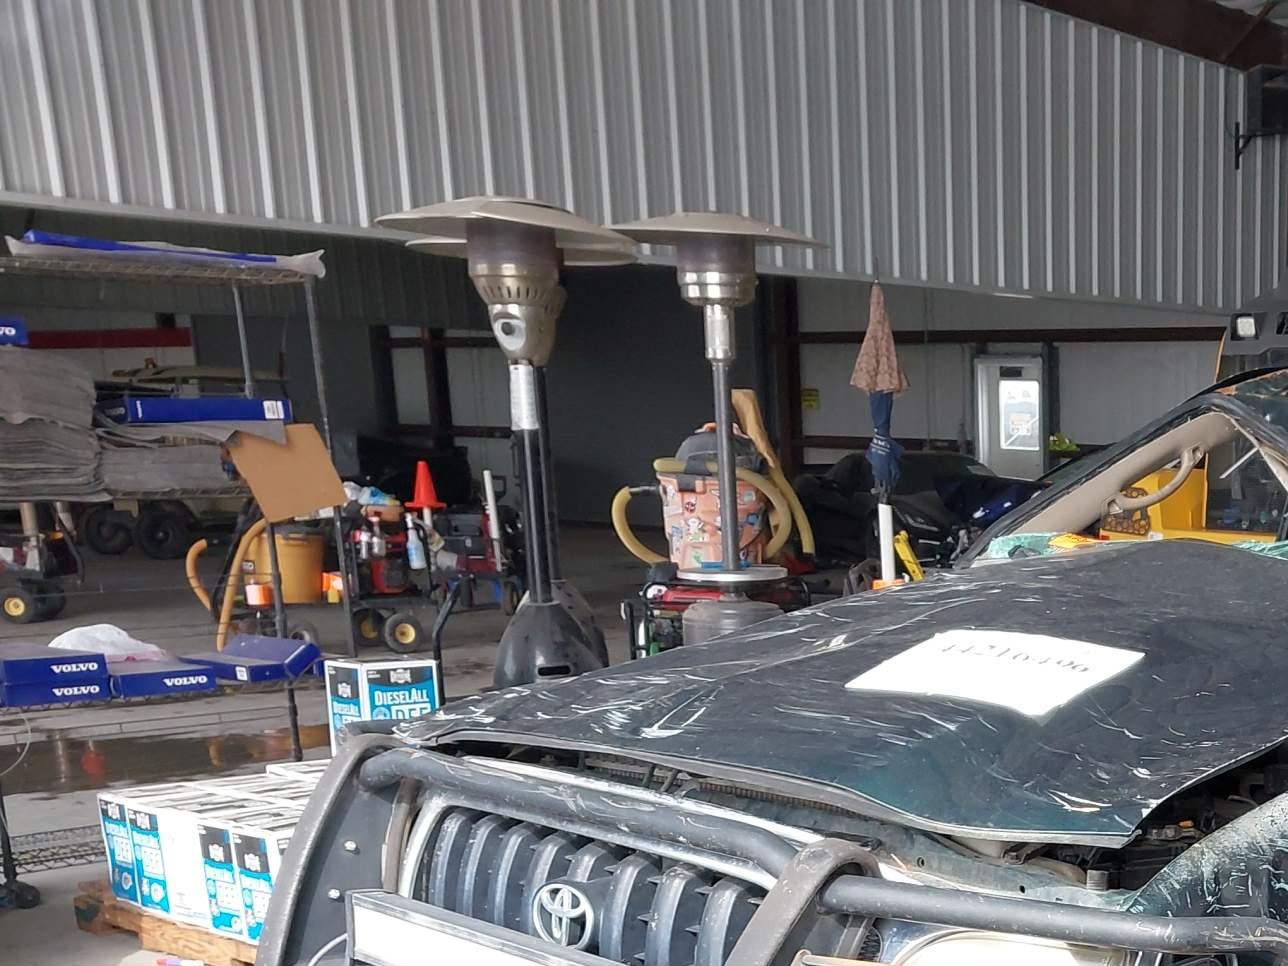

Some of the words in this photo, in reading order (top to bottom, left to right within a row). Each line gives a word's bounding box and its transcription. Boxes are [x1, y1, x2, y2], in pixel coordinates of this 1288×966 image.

[50, 661, 99, 674] VOLVO
[162, 675, 209, 687] VOLVO
[52, 684, 100, 697] VOLVO
